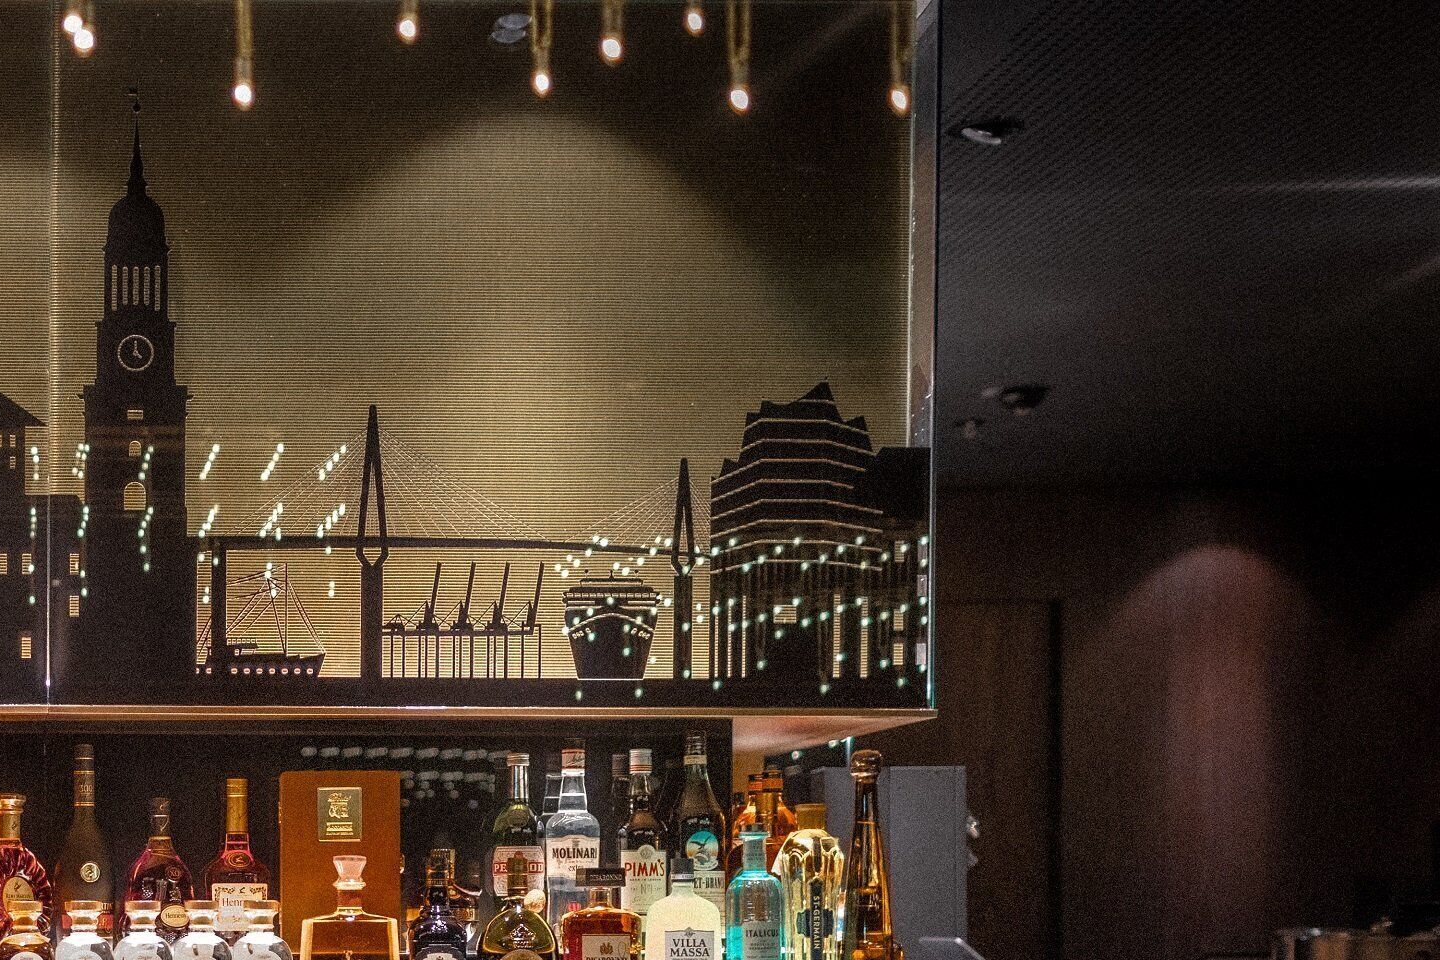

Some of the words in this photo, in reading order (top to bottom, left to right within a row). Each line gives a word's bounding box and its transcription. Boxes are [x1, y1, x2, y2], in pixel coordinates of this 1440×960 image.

[552, 847, 597, 859] MOLINARI
[812, 895, 821, 950] ST-GERMAIN
[746, 929, 779, 937] ITALICUS
[672, 938, 707, 947] VILLA
[670, 948, 710, 957] MASSA
